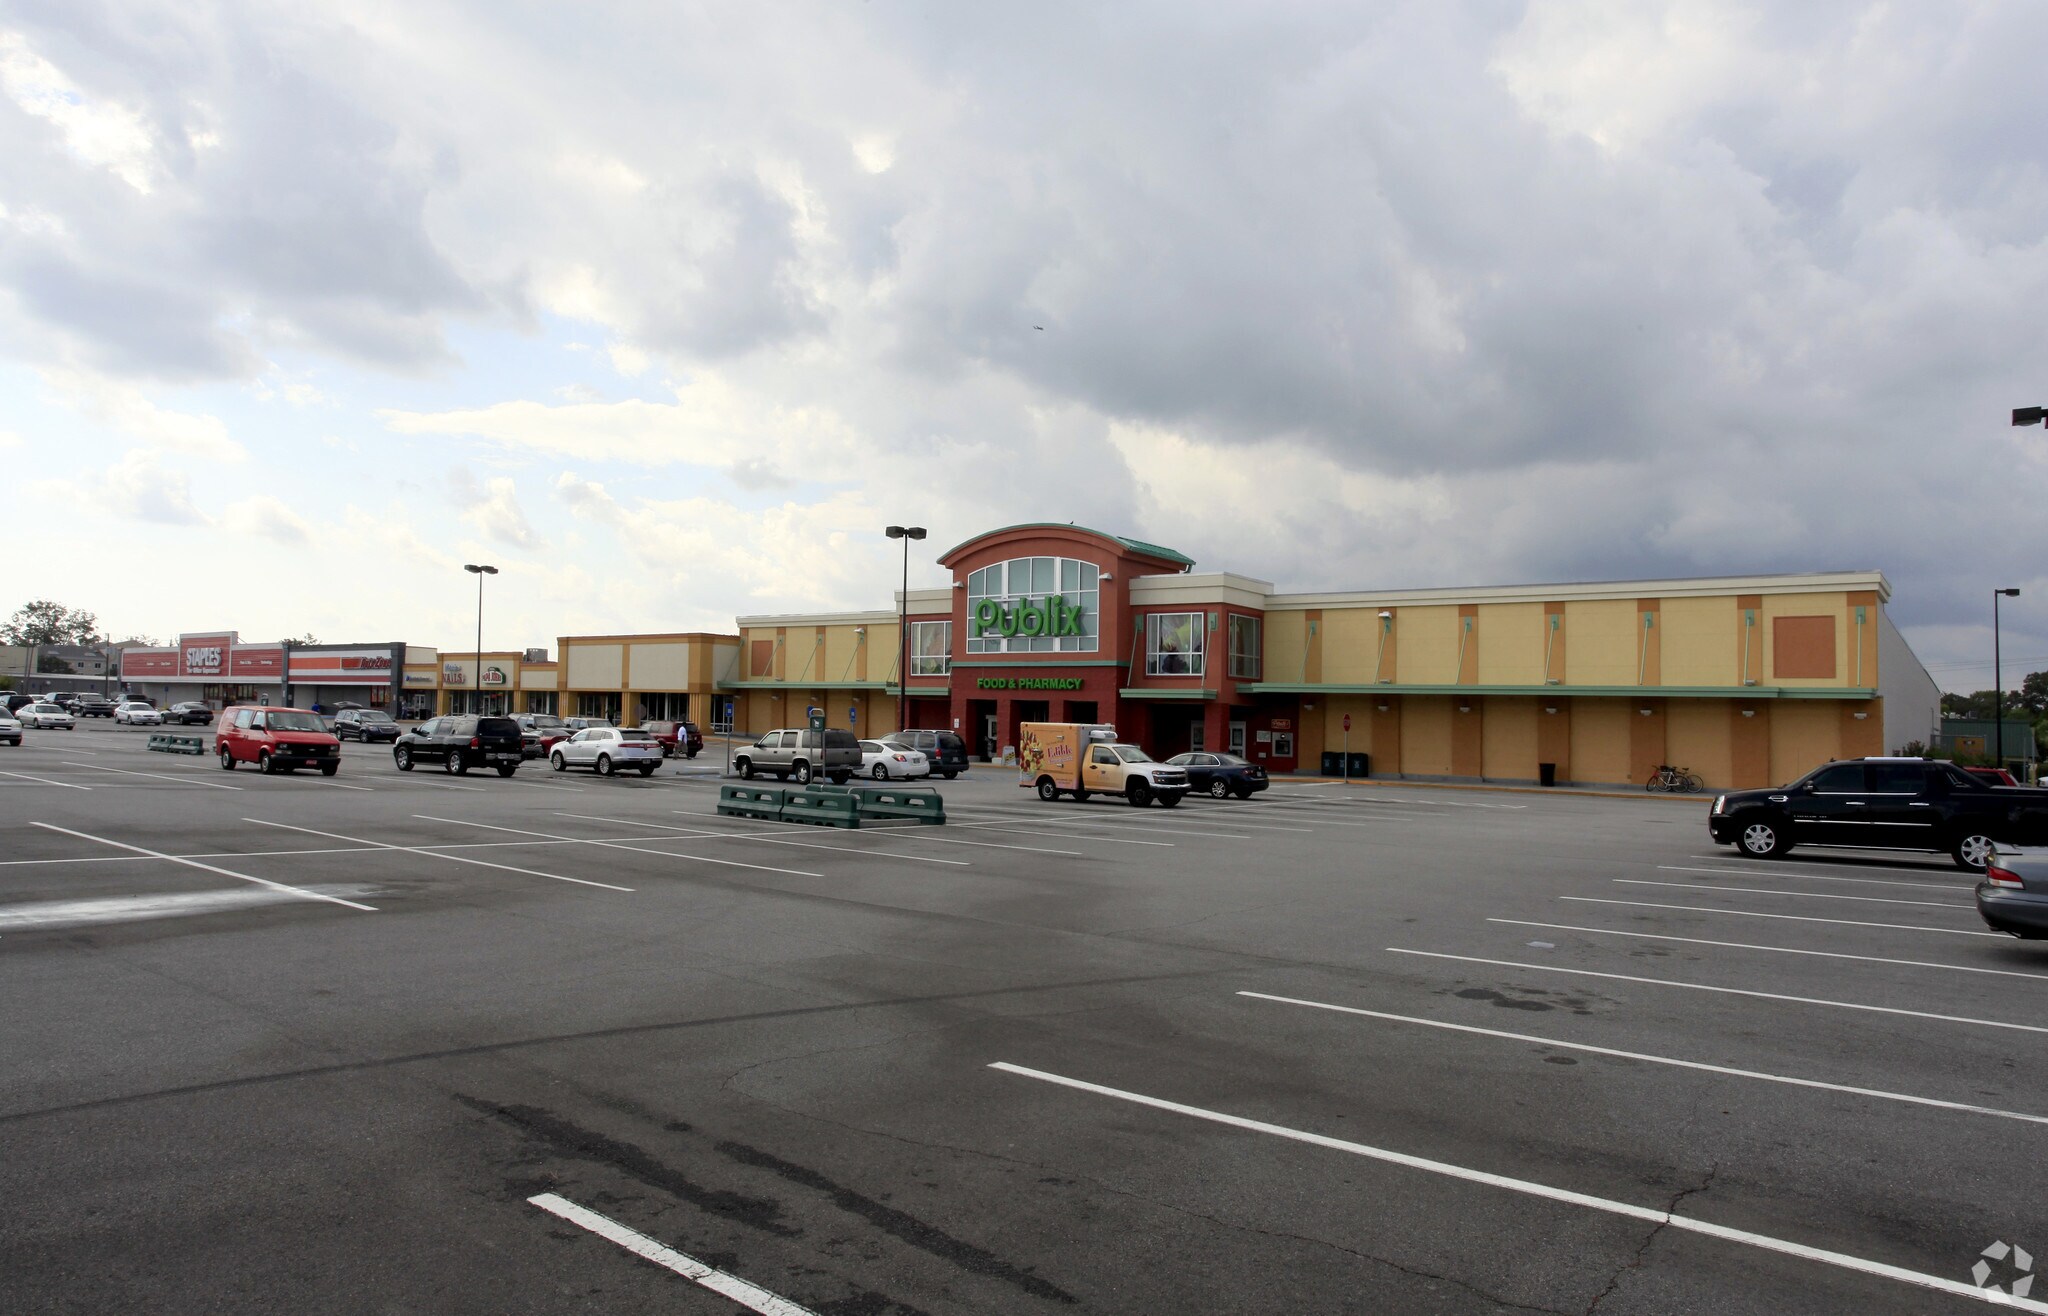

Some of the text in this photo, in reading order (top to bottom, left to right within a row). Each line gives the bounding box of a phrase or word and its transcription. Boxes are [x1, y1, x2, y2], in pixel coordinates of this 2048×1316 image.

[974, 594, 1083, 638] Publix
[187, 648, 222, 666] STAPLES
[977, 678, 1083, 690] FOOD & PHARMACY
[1047, 745, 1073, 758] Edible
